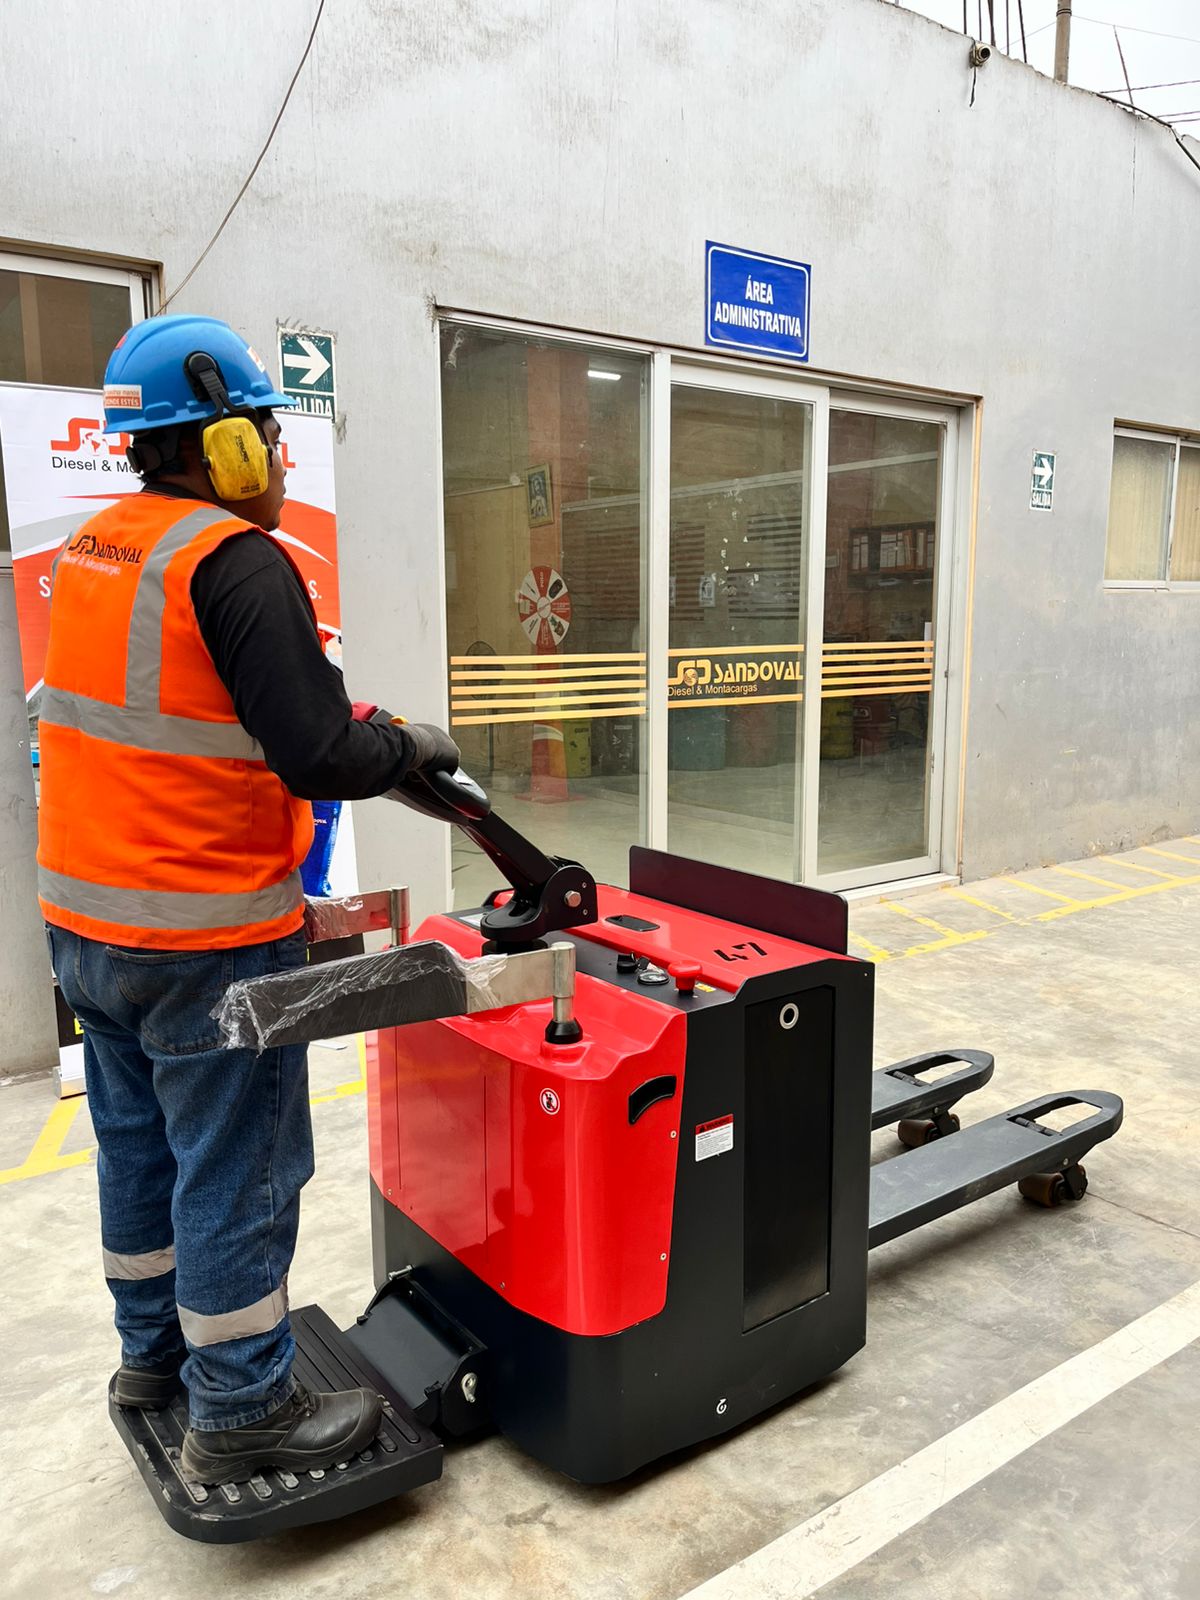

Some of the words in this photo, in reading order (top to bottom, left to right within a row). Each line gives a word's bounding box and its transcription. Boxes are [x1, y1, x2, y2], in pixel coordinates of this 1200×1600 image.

[745, 274, 774, 305] ÁREA
[714, 301, 802, 338] ADMINISTRATIVA
[52, 456, 97, 471] Diesel
[101, 460, 112, 472] &
[94, 542, 143, 564] SANDOVAL
[713, 661, 803, 683] SANDOVAL
[667, 686, 694, 697] Diesel
[696, 685, 703, 695] &
[705, 683, 758, 696] Montacargas
